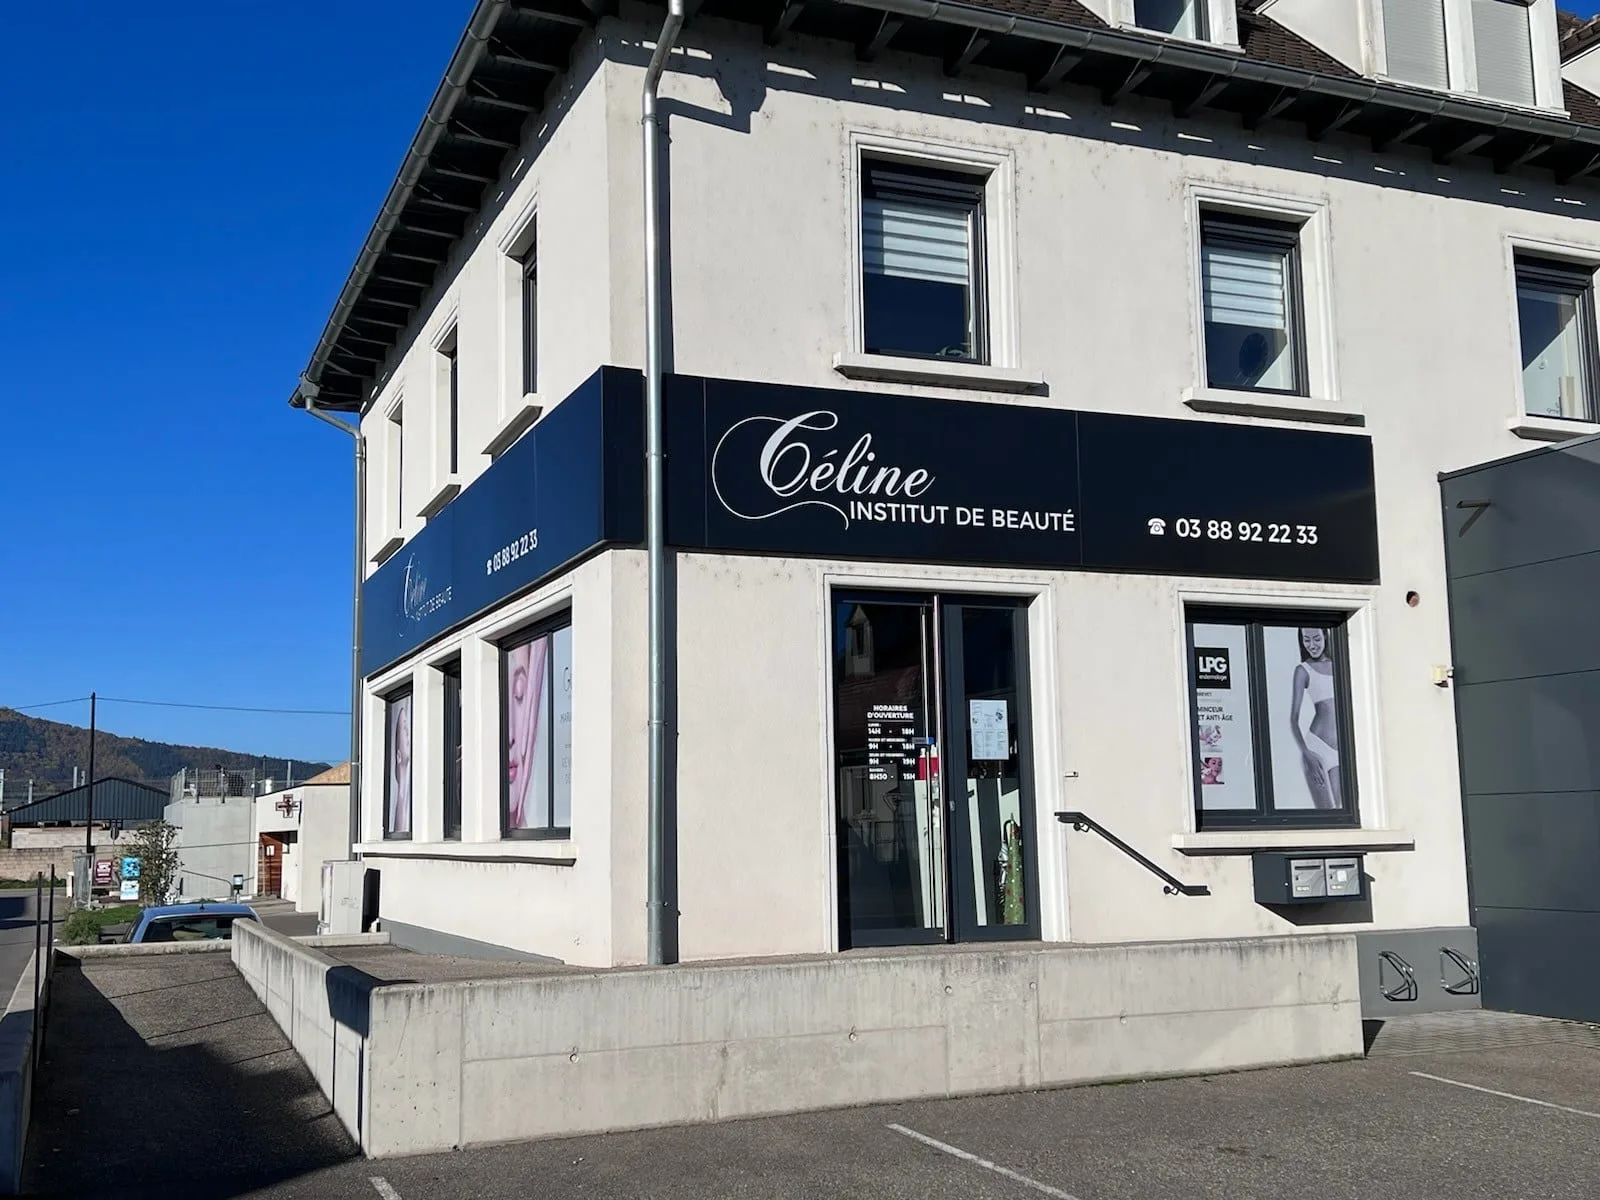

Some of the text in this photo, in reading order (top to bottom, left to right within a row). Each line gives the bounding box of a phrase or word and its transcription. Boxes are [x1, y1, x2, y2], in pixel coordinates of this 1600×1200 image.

[712, 410, 935, 530] Céline
[850, 500, 1075, 532] INSTITUT DE BEAUTÉ
[1175, 518, 1318, 545] 03 88 92 22 33
[502, 546, 510, 567] 88
[510, 540, 519, 561] 92
[520, 534, 529, 556] 22
[529, 528, 538, 550] 33
[1198, 656, 1227, 673] LPG
[866, 711, 914, 719] D'OUVERTURE
[873, 704, 908, 712] HORAIRES
